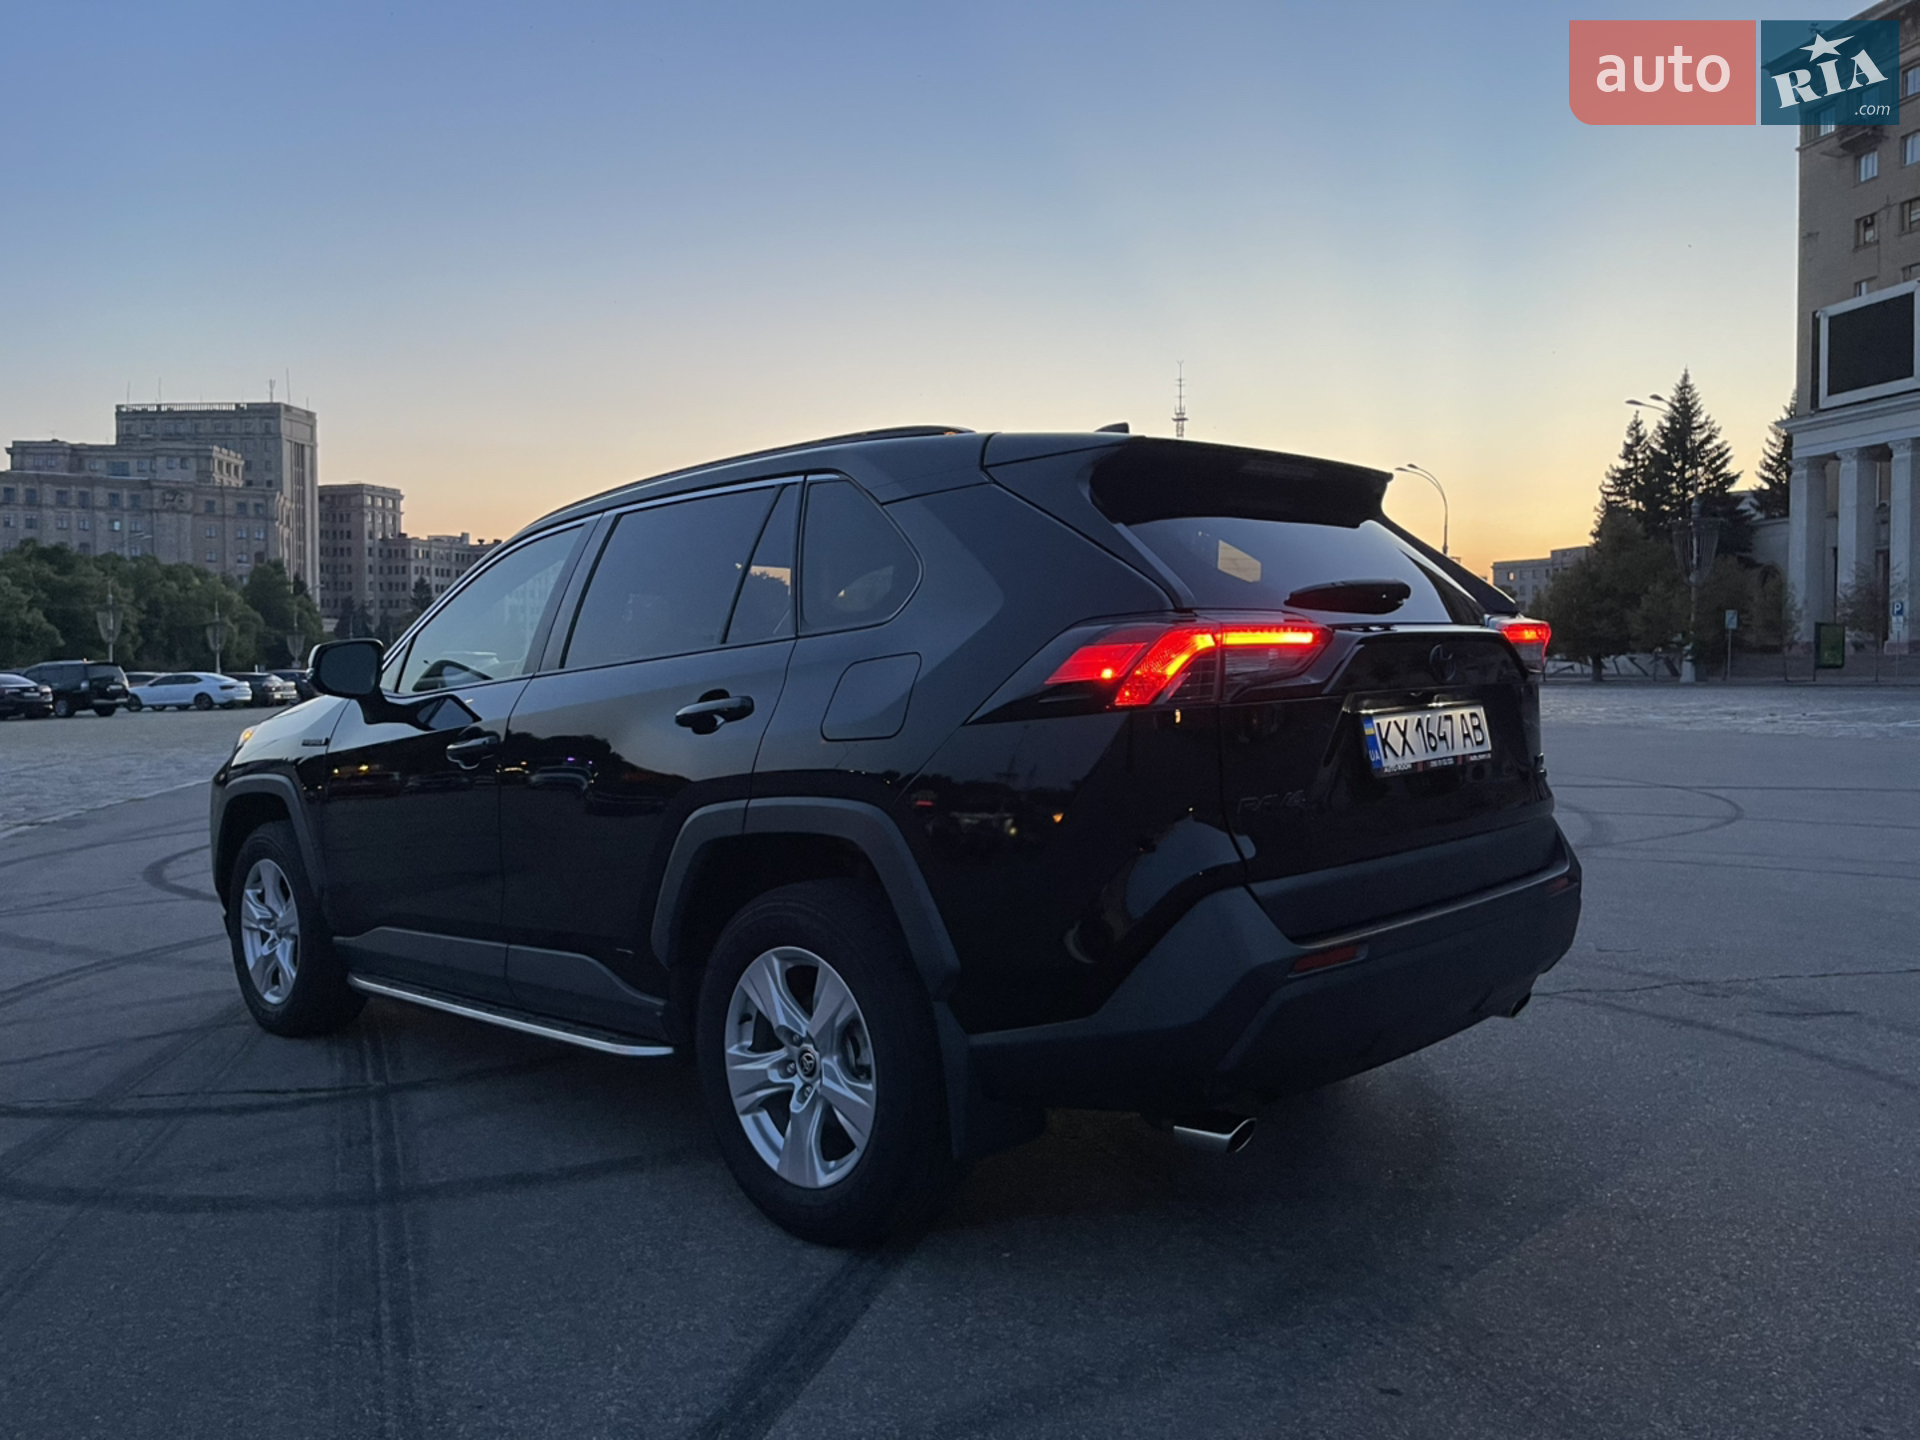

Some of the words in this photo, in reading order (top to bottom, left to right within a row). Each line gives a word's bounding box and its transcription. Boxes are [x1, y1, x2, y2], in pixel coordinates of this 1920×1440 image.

[1894, 602, 1902, 615] P
[1376, 719, 1415, 759] KX
[1415, 714, 1455, 753] 1647
[1460, 712, 1485, 748] AB
[1368, 749, 1382, 762] UA
